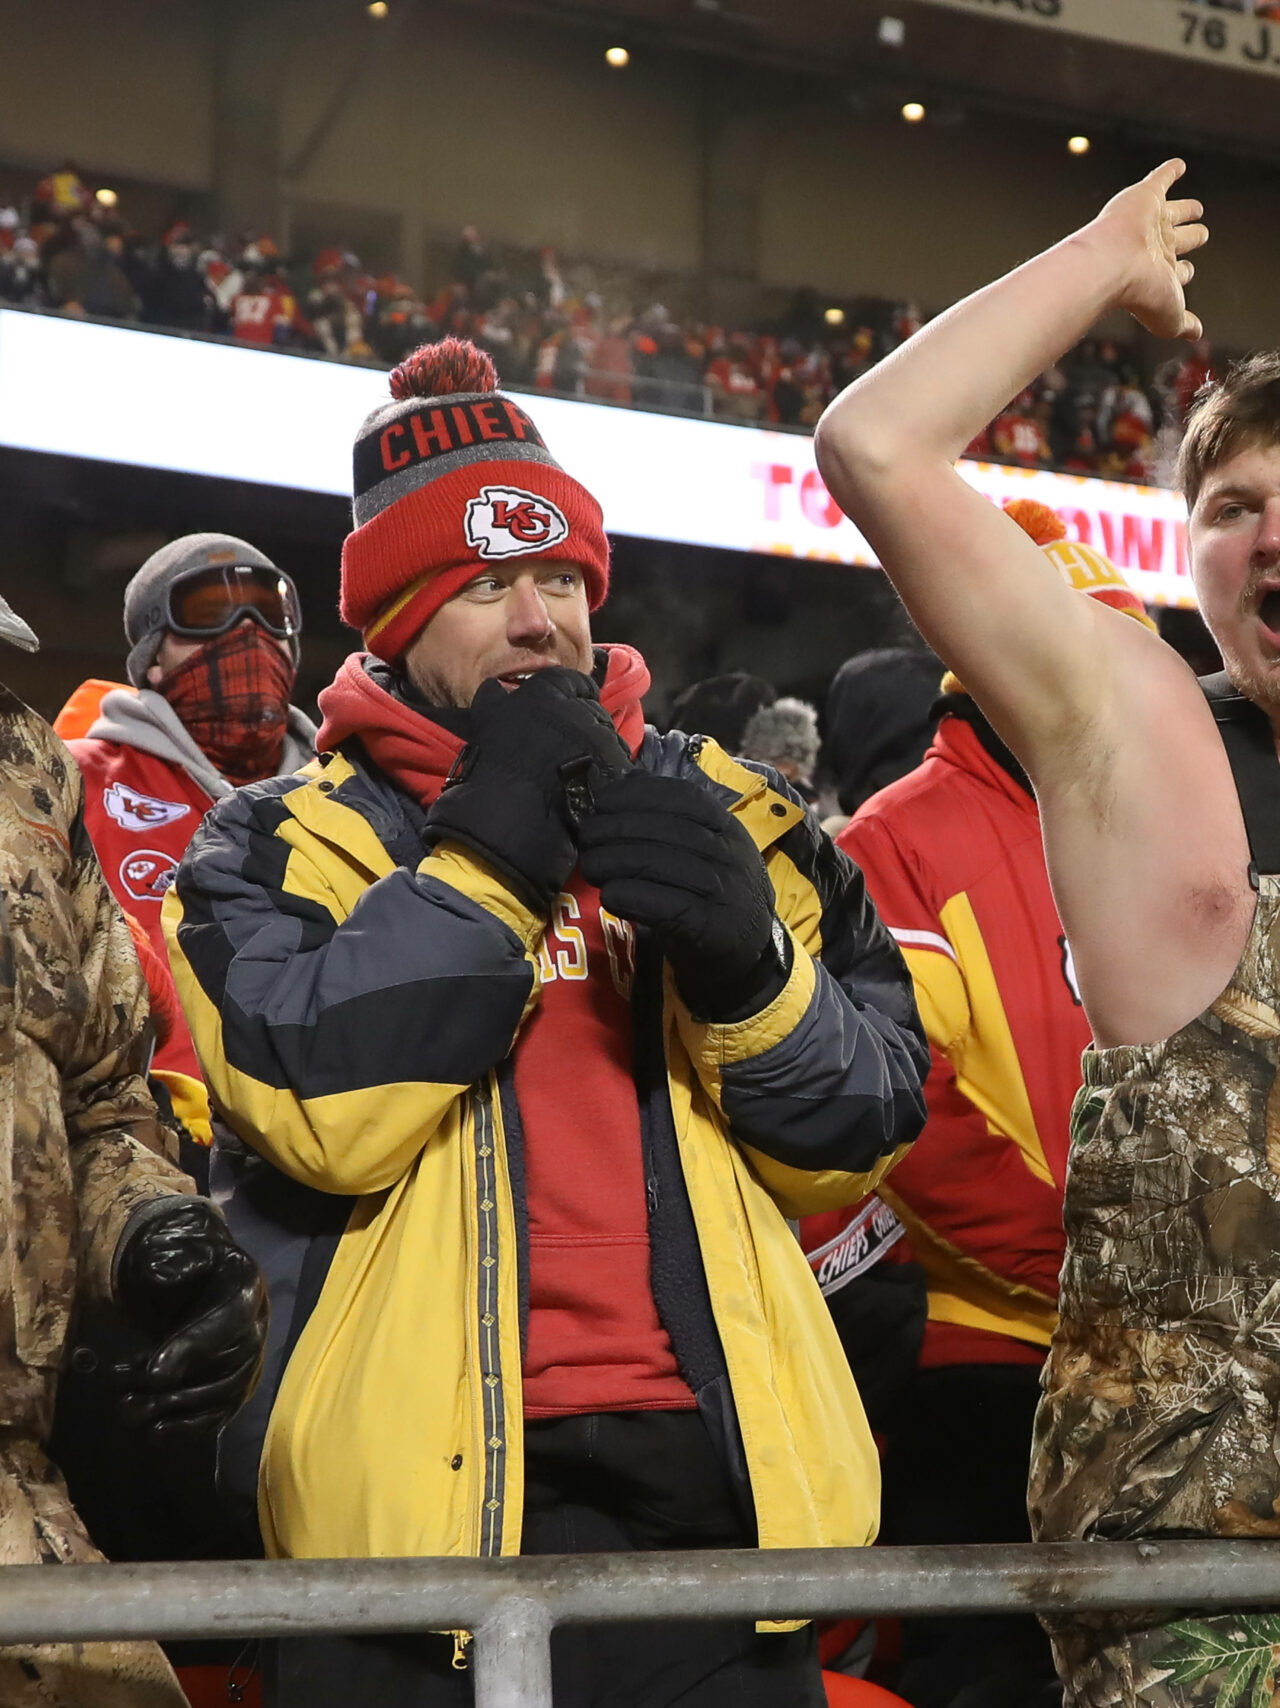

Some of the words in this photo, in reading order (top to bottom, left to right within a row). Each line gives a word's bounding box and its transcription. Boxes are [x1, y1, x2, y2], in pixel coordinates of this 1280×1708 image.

[1179, 11, 1227, 50] 76
[380, 401, 547, 471] CHIEF
[491, 501, 551, 542] KC
[818, 1225, 869, 1284] CHIEFS
